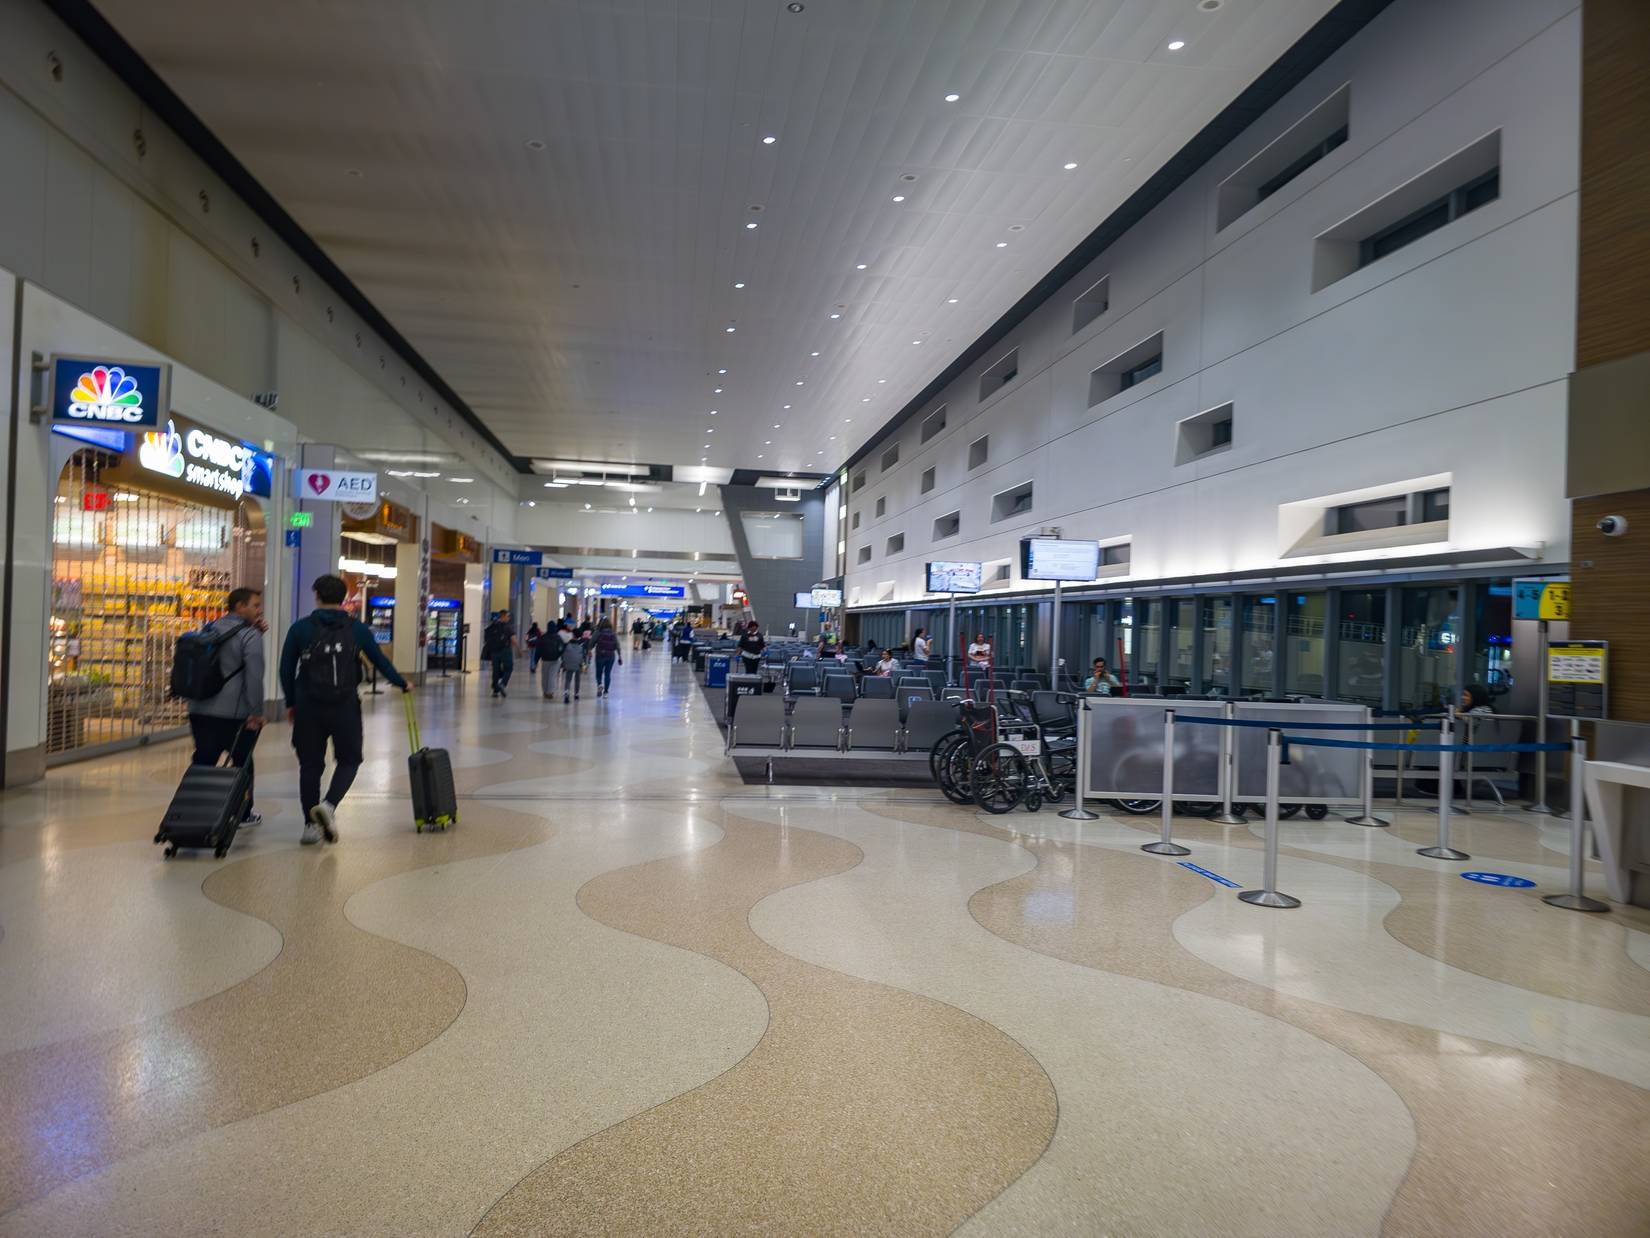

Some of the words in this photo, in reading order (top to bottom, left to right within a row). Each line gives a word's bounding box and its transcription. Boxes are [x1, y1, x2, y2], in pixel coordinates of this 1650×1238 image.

[68, 402, 144, 422] CNBC
[187, 429, 245, 471] CNBC
[337, 477, 372, 491] AED
